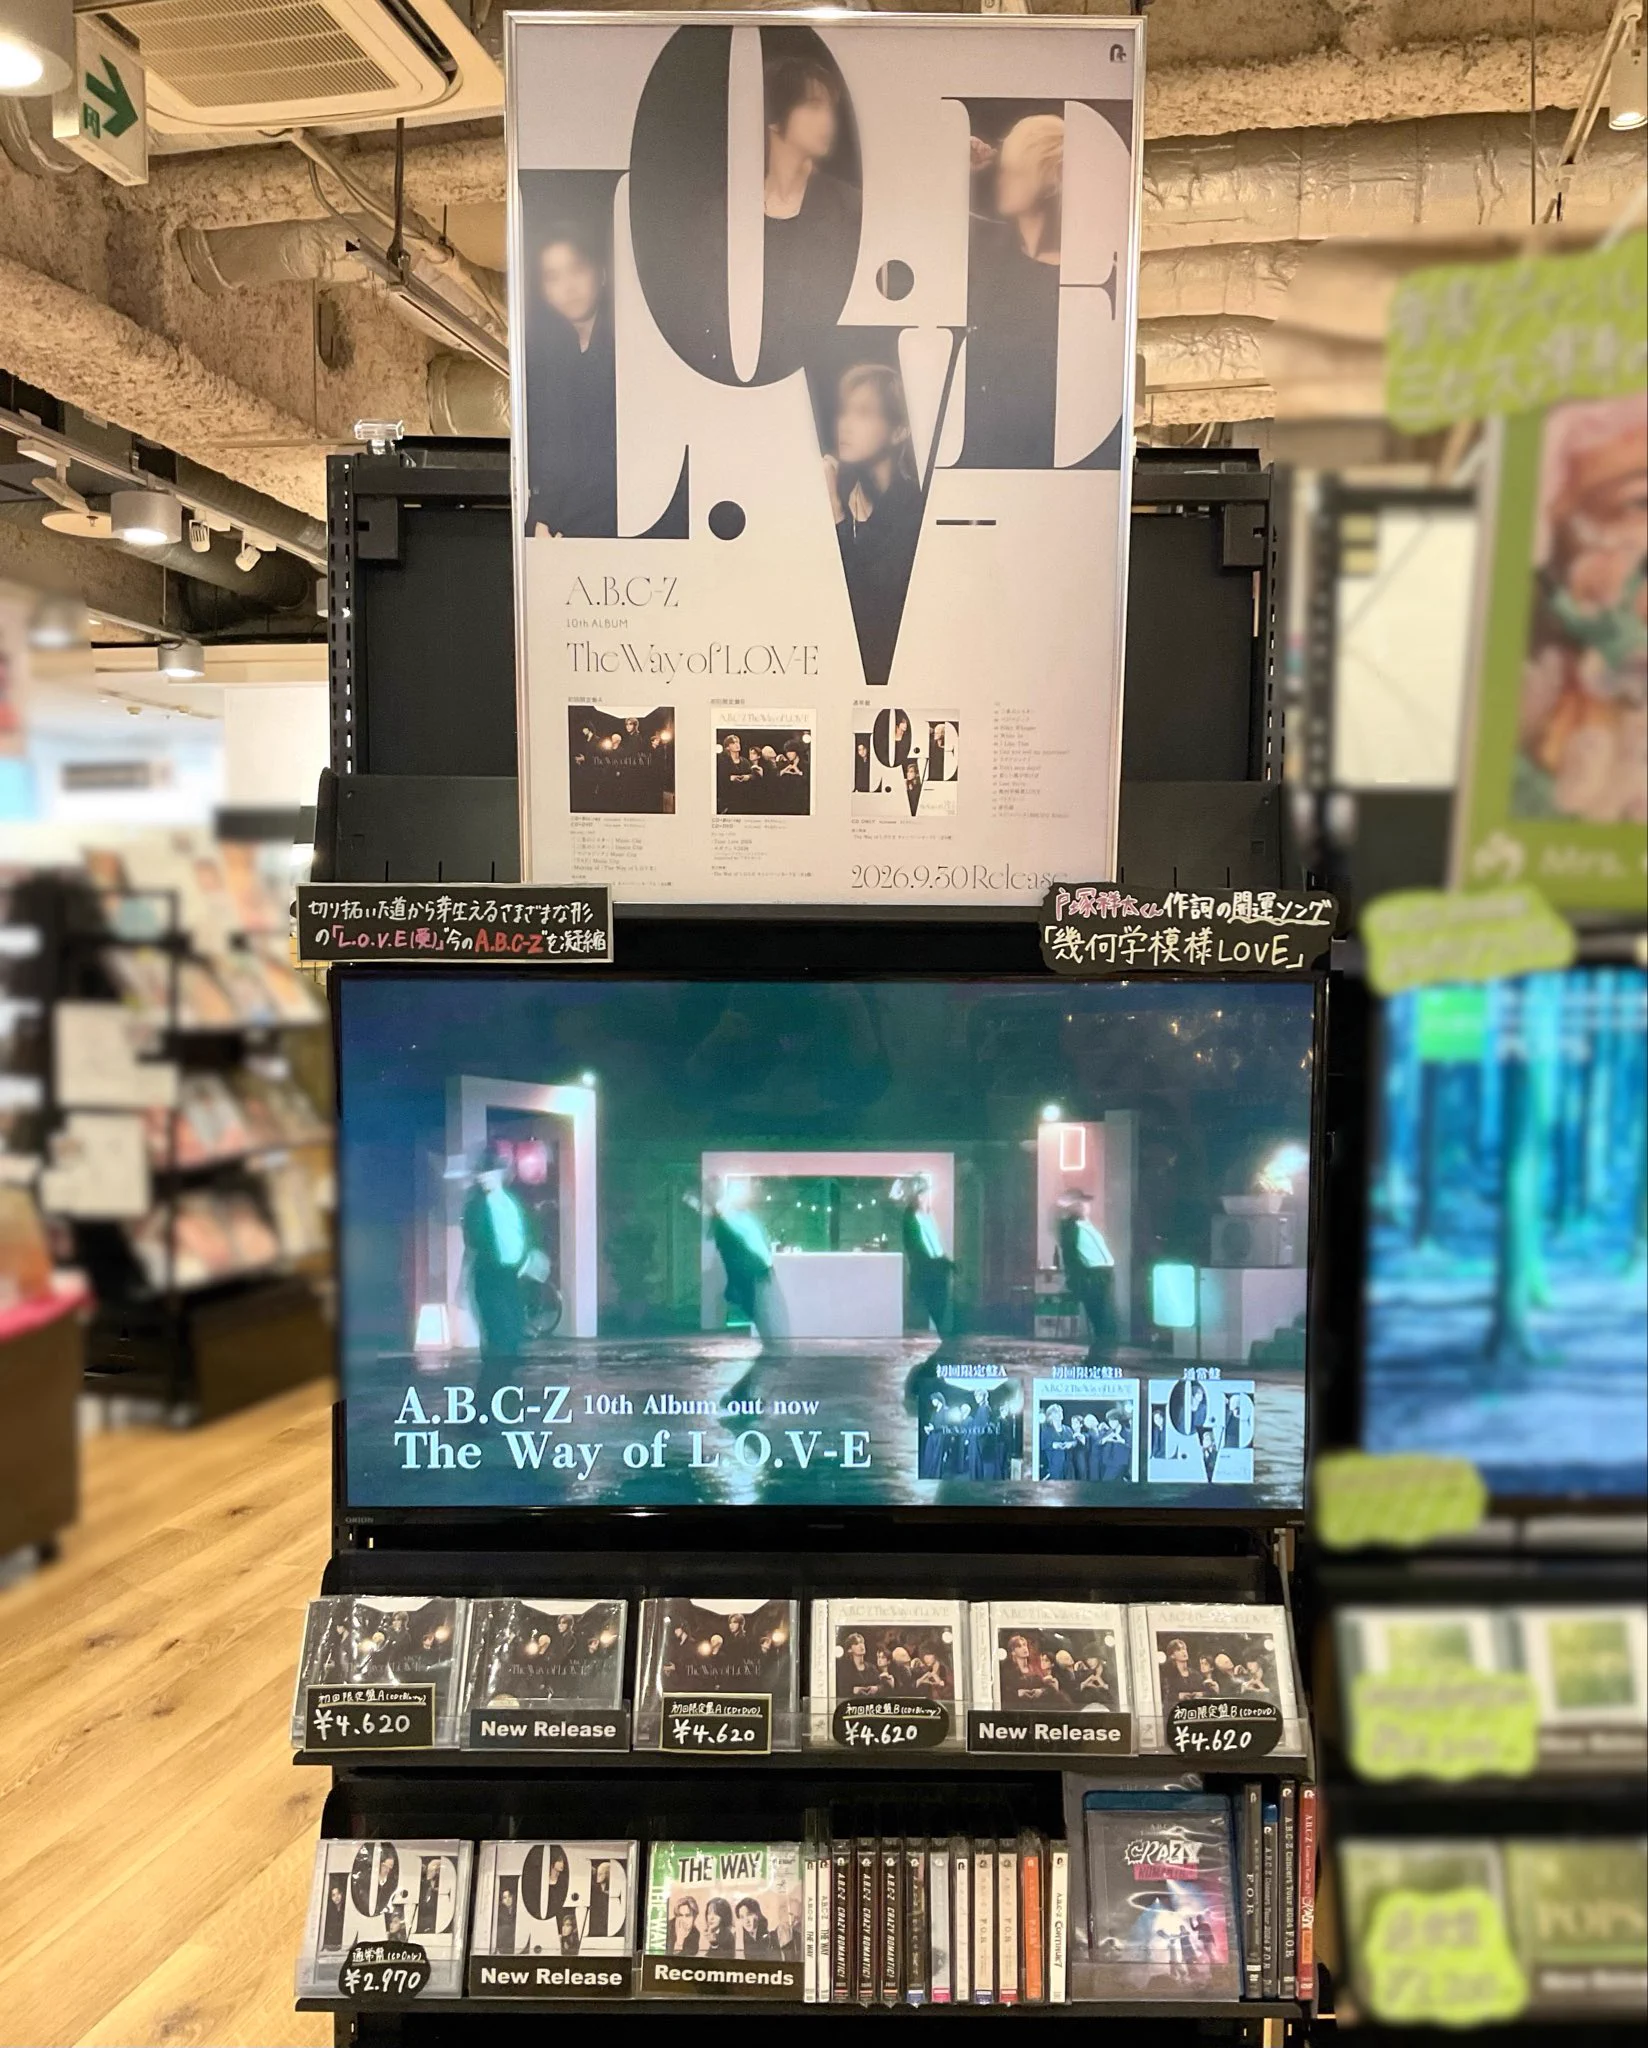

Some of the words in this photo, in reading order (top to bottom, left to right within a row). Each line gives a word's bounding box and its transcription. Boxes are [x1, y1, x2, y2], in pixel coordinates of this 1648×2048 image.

[566, 576, 679, 606] A.B.C-Z
[566, 618, 589, 629] 10th
[592, 618, 628, 629] ALBUM
[567, 641, 620, 673] The
[620, 643, 684, 684] Way
[687, 641, 721, 674] of
[308, 896, 594, 923] 切り拓いた道から芽生えるさまざまな形
[1056, 888, 1332, 921] 戸塚祥太くん作詞の開運ソング
[1044, 925, 1304, 968] 「幾何学模様LOVE」
[394, 1386, 573, 1425] A.B.C-Z
[583, 1393, 634, 1415] 10th
[643, 1393, 717, 1415] Album
[727, 1397, 763, 1415] out
[774, 1399, 820, 1415] now
[394, 1430, 482, 1469] The
[502, 1431, 603, 1480] Way
[623, 1430, 671, 1468] of
[688, 1430, 873, 1469] L.O.V-E
[481, 1720, 527, 1736] New
[534, 1720, 616, 1738] Release
[979, 1723, 1028, 1740] New
[1035, 1724, 1122, 1741] Release
[679, 1855, 713, 1883] THE
[721, 1851, 761, 1880] WAY
[1286, 1885, 1294, 1905] Tour
[837, 1907, 846, 1933] CRAZY
[862, 1908, 871, 1934] CRAZY
[886, 1907, 895, 1933] CRAZY
[806, 1931, 814, 1943] THE
[821, 1929, 829, 1944] THE
[806, 1944, 814, 1958] WAY
[820, 1945, 829, 1956] WAY
[481, 1967, 530, 1985] New
[536, 1968, 623, 1986] Release
[654, 1963, 794, 1986] Recommends
